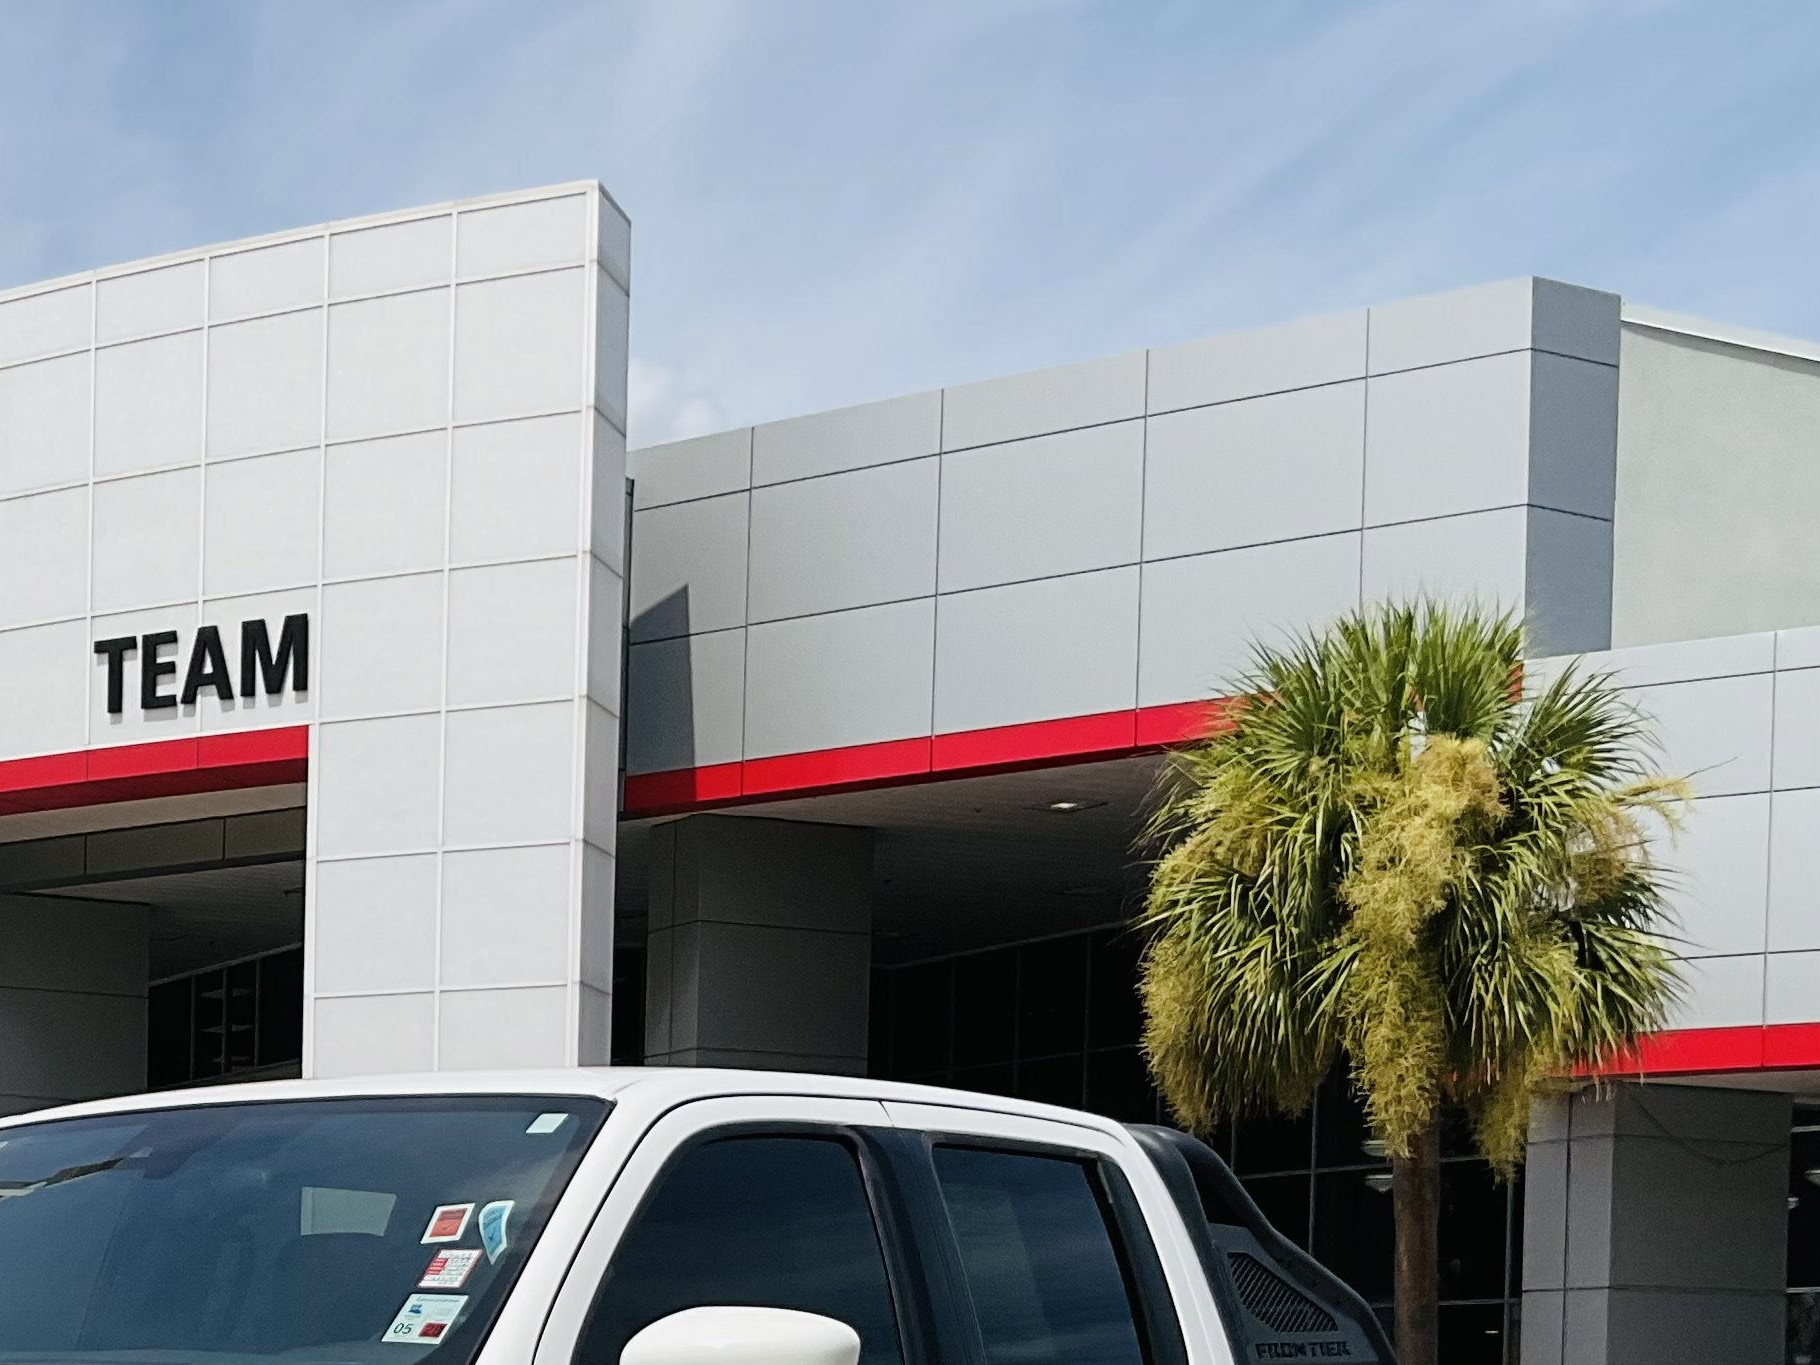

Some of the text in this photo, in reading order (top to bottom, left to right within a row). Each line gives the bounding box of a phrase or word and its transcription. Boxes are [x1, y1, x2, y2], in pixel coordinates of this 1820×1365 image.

[94, 613, 309, 714] TEAM
[393, 1322, 414, 1335] 05
[1255, 1341, 1351, 1360] FRONTIER
